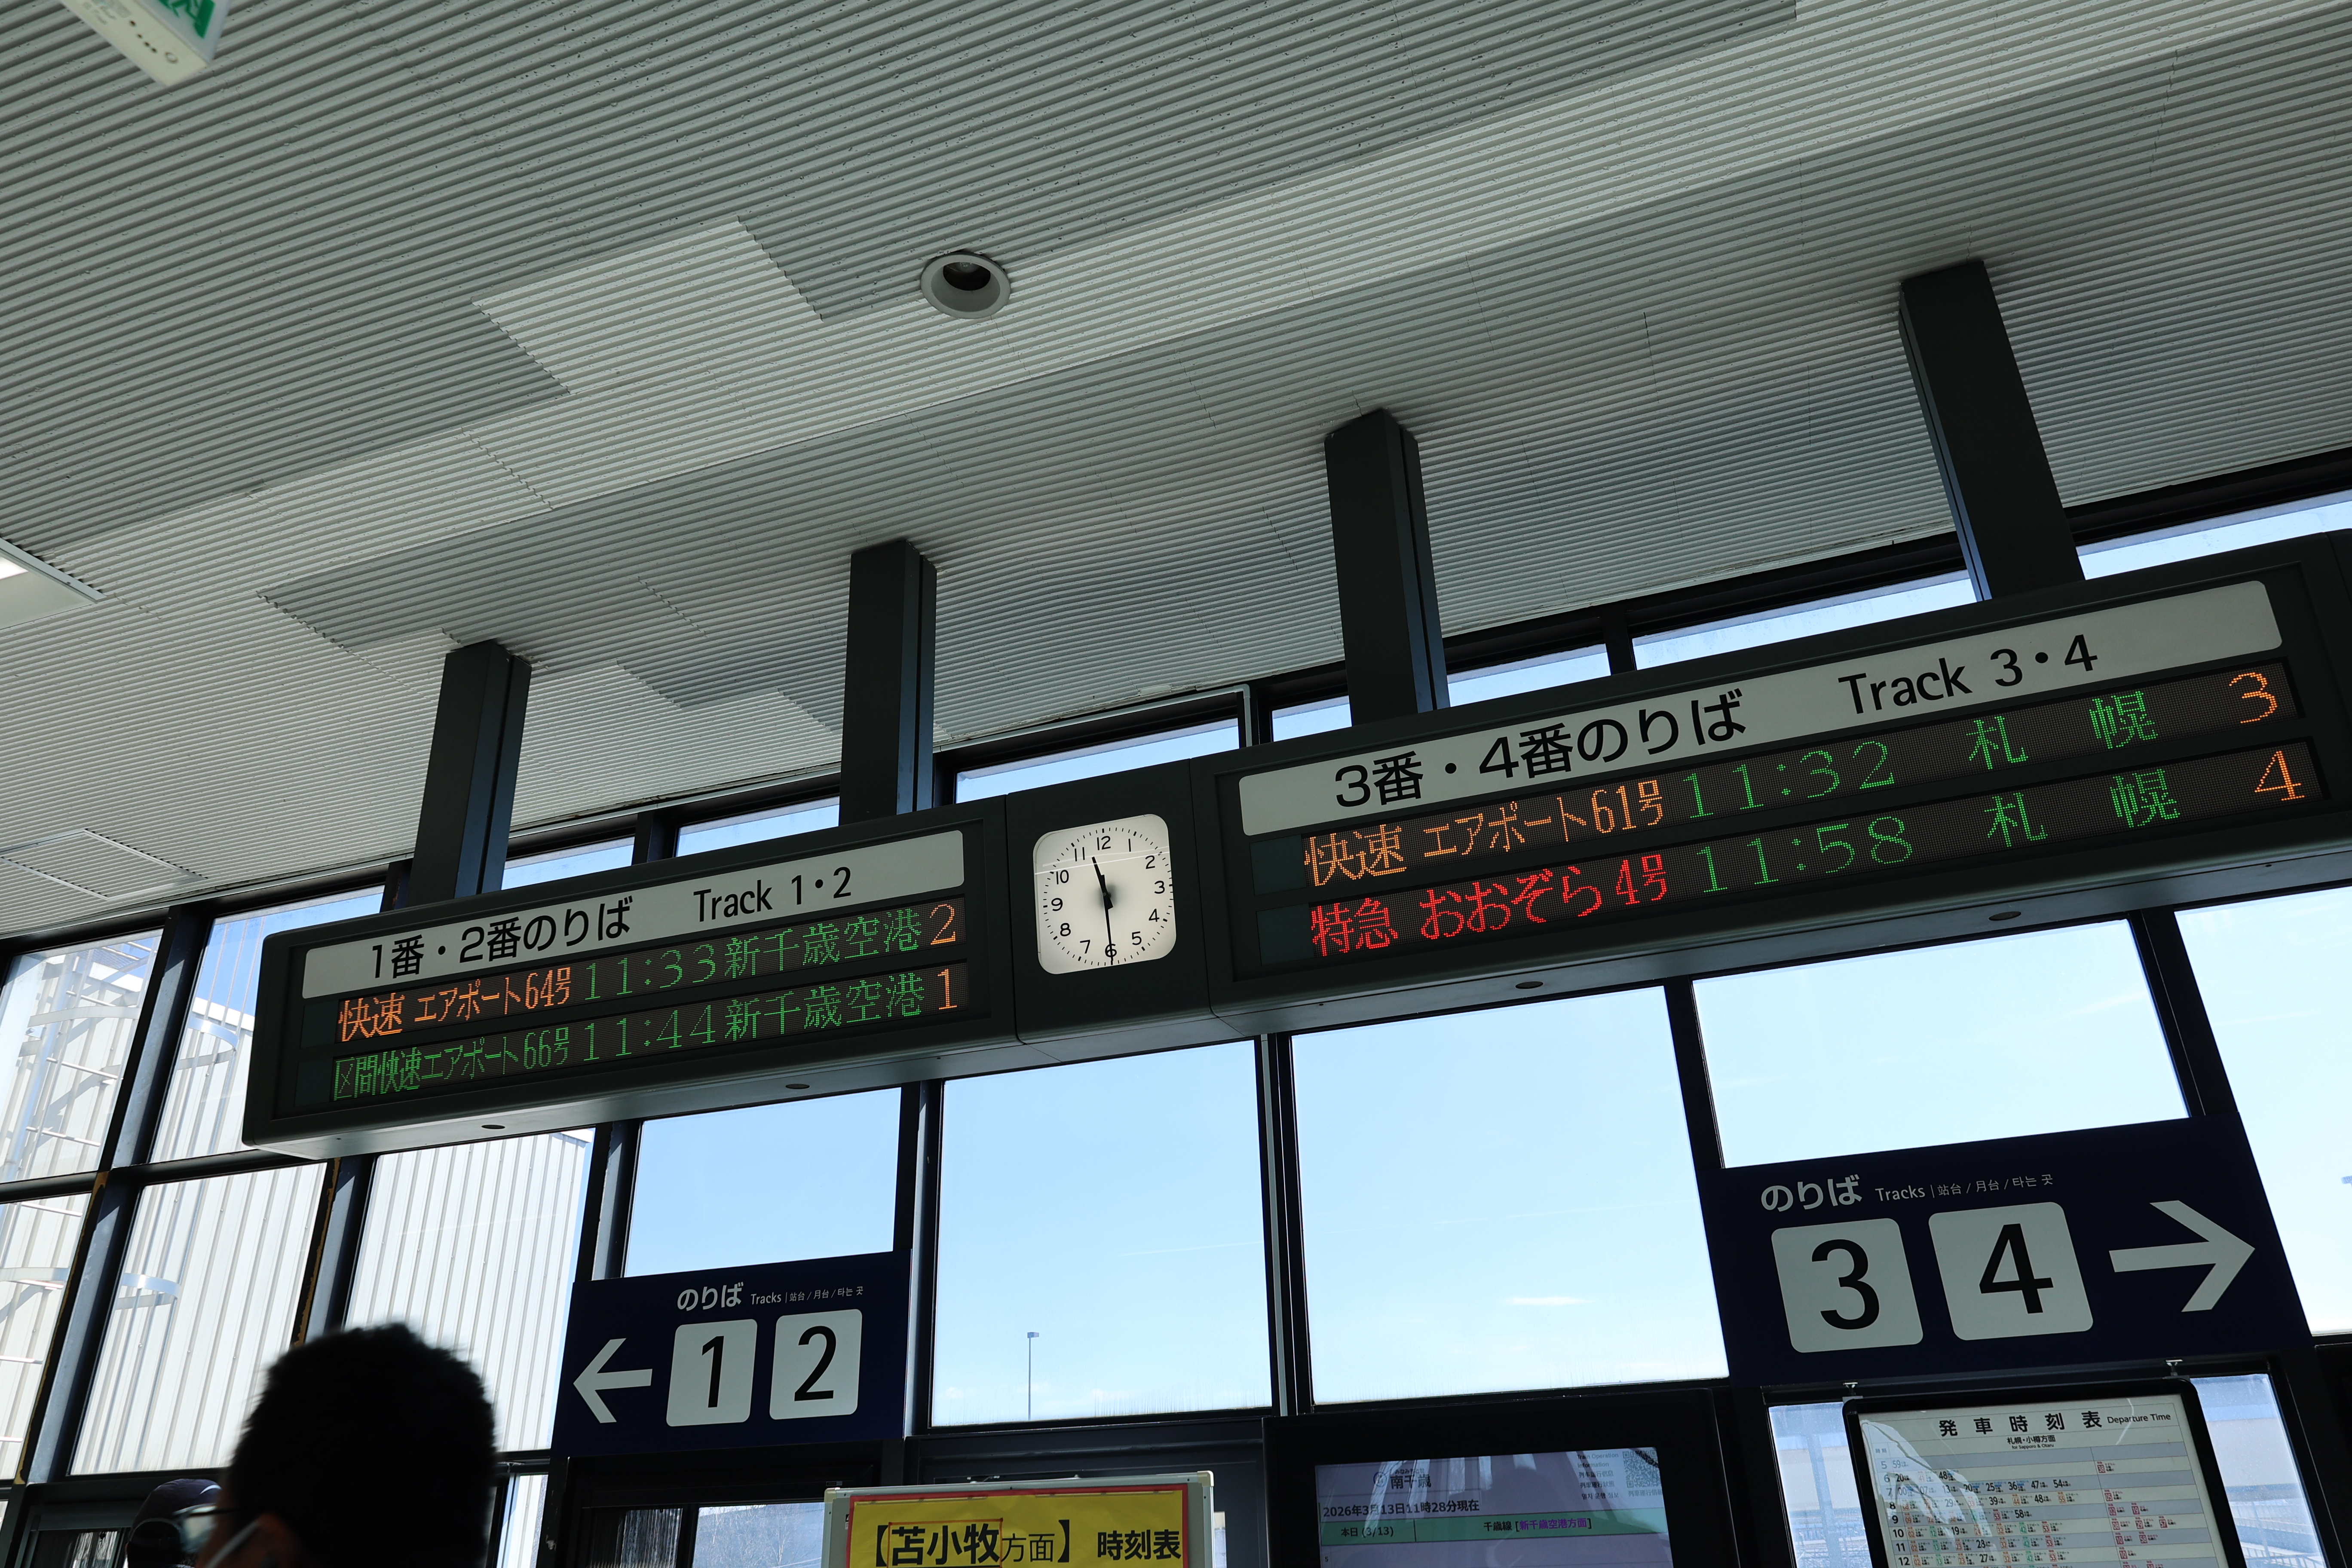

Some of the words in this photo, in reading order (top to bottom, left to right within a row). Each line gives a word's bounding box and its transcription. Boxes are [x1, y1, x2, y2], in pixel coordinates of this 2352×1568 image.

[1335, 688, 1747, 807] 3番・4番のりば
[1838, 658, 1972, 714] Track
[1303, 824, 1407, 886] 快速
[1424, 779, 1664, 858] エアポート61号
[1683, 741, 1896, 821] 11:32
[2229, 671, 2277, 723] 3
[1097, 836, 1111, 850] 12
[1128, 839, 1131, 852] 1
[1075, 847, 1085, 862] 11
[1310, 898, 1398, 956] 特急
[1696, 815, 1912, 894] 11:58
[2254, 750, 2305, 802] 4
[1145, 855, 1155, 869] 2
[1056, 870, 1069, 885] 10
[1154, 881, 1165, 894] 3
[1051, 898, 1063, 911] 9
[1148, 909, 1160, 922] 4
[372, 896, 633, 978] 1番・2番のりば
[693, 879, 773, 922] Track
[1060, 923, 1071, 936] 8
[1132, 931, 1142, 945] 5
[1080, 940, 1090, 954] 7
[1105, 943, 1117, 958] 6
[338, 993, 406, 1043] 快速
[414, 967, 571, 1022] エアポート64号
[586, 944, 716, 1000] 11:33
[724, 908, 922, 979] 新千歳空港
[929, 903, 956, 945] 2
[334, 1028, 569, 1101] 区間快速エアポート66号
[584, 1005, 716, 1061] 11:44
[724, 973, 925, 1041] 新千歳空港
[937, 969, 957, 1010] 1
[1760, 1175, 1862, 1213] のりば
[1875, 1185, 1925, 1201] Tracks
[1938, 1183, 1961, 1196] 站台
[1976, 1179, 1999, 1192] 月台
[2012, 1176, 2037, 1188] 타는
[2041, 1174, 2053, 1186] 곳
[1978, 1223, 2054, 1315] 4
[1810, 1239, 1880, 1331] 3
[677, 1282, 744, 1311] のりば
[751, 1294, 781, 1305] Tracks
[701, 1335, 724, 1408] 1
[794, 1326, 836, 1402] 2
[2107, 1416, 2148, 1424] Departure
[1881, 1461, 1887, 1469] 5
[1390, 1474, 1431, 1489] 南千歳
[1884, 1474, 1890, 1482] 6
[1939, 1471, 1948, 1479] 48
[1886, 1488, 1892, 1496] 7
[1898, 1487, 1907, 1495] 00
[1920, 1486, 1928, 1494] 07
[1943, 1485, 1950, 1493] 13
[1986, 1483, 1995, 1491] 25
[2008, 1482, 2017, 1490] 36
[2031, 1480, 2039, 1489] 47
[2053, 1479, 2062, 1488] 54
[1945, 1499, 1953, 1507] 29
[1989, 1497, 1998, 1505] 39
[2034, 1494, 2043, 1503] 48
[1323, 1500, 1479, 1517] 2026年3月13日11時28分現在
[1892, 1516, 1899, 1524] 9
[2015, 1509, 2024, 1518] 58
[1341, 1528, 1358, 1537] 本日
[1362, 1526, 1393, 1537] (3/13)
[1483, 1522, 1512, 1532] 千歳線
[1893, 1529, 1904, 1537] 10
[1951, 1526, 1960, 1535] 19
[1097, 1529, 1182, 1561] 時刻表
[1896, 1543, 1905, 1552] 11
[1899, 1557, 1910, 1565] 12
[1980, 1554, 1988, 1562] 27
